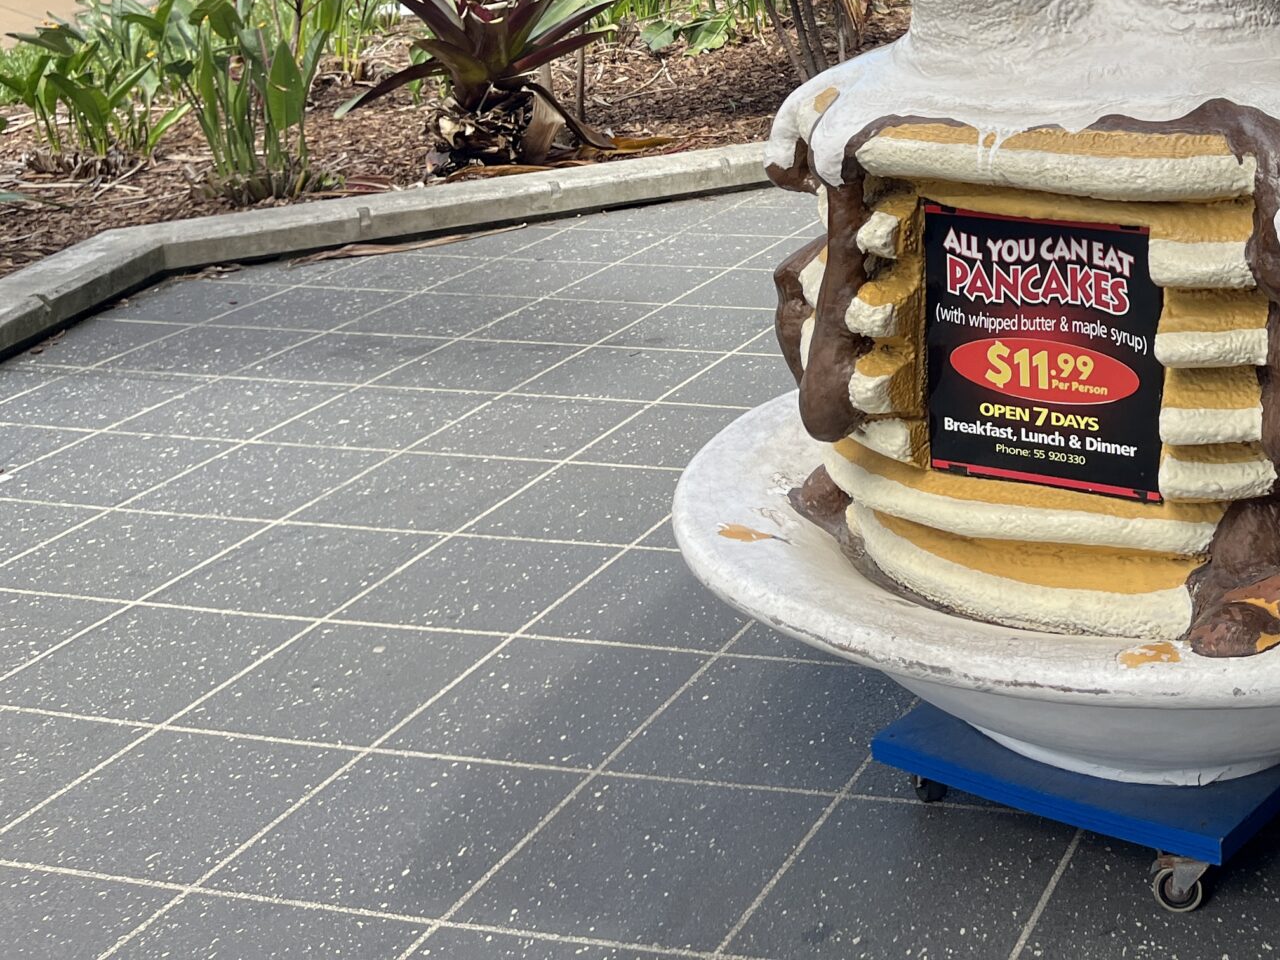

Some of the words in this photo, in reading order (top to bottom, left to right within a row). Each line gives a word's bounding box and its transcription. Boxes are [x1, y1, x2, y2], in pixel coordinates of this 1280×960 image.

[943, 227, 982, 261] ALL
[986, 237, 1036, 262] YOU
[1040, 237, 1088, 263] CAN
[1091, 242, 1135, 277] EAT
[946, 253, 1130, 316] PANCAKES
[935, 302, 966, 326] (with
[968, 313, 1018, 334] whipped
[1020, 314, 1056, 331] butter
[1059, 316, 1069, 331] &
[1072, 320, 1107, 340] maple
[1110, 328, 1148, 355] syrup)
[985, 340, 1095, 390] $11.99
[1051, 378, 1070, 391] Per
[1071, 381, 1108, 396] Person
[943, 417, 1018, 443] Breakfast,
[1020, 428, 1064, 448] Lunch
[1068, 434, 1082, 449] &
[1085, 437, 1137, 458] Dinner
[979, 403, 1030, 422] OPEN
[1032, 407, 1049, 427] 7
[1051, 411, 1100, 431] DAYS
[995, 443, 1031, 458] Phone:
[1033, 449, 1046, 460] 55
